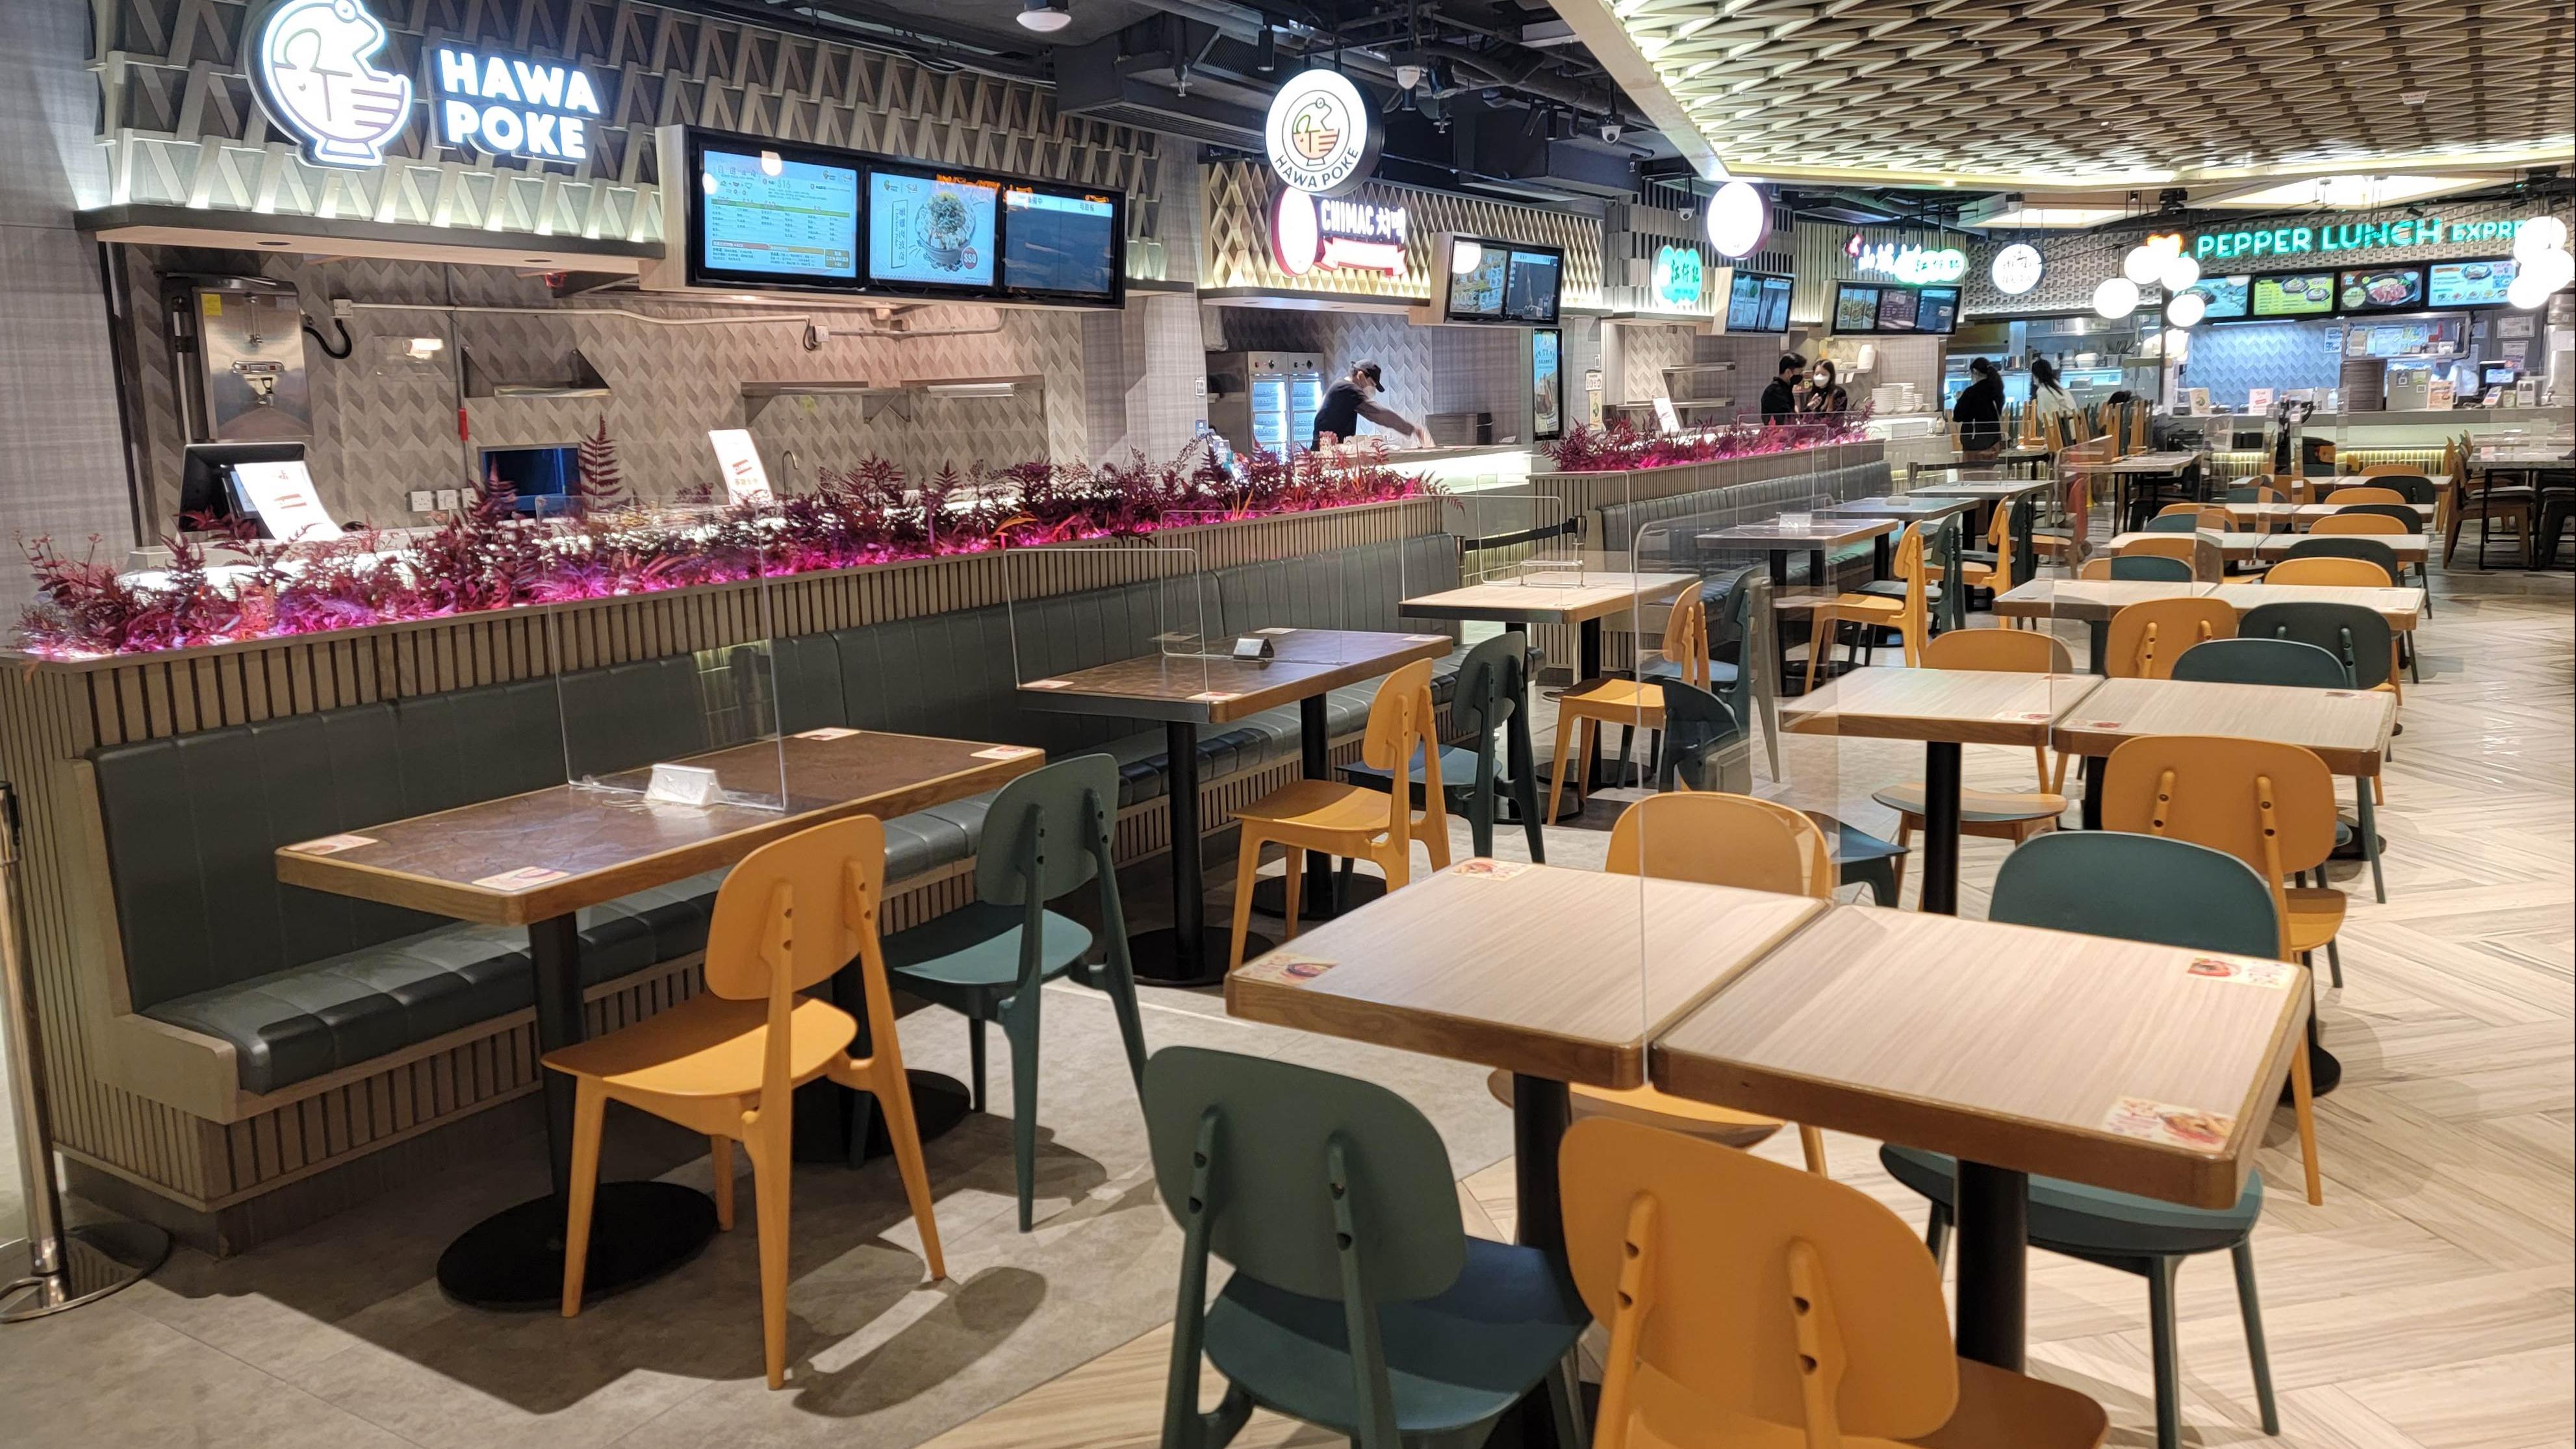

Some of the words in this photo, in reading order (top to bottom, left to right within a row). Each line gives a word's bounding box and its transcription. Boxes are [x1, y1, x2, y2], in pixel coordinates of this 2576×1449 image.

[440, 49, 600, 114] HAWA
[445, 99, 586, 159] POKE
[1275, 155, 1318, 188] HAWA
[1321, 147, 1359, 186] POKE
[1320, 199, 1375, 236] CHIMAC
[2197, 227, 2313, 258] PEPPER
[2321, 217, 2442, 251] LUNCH
